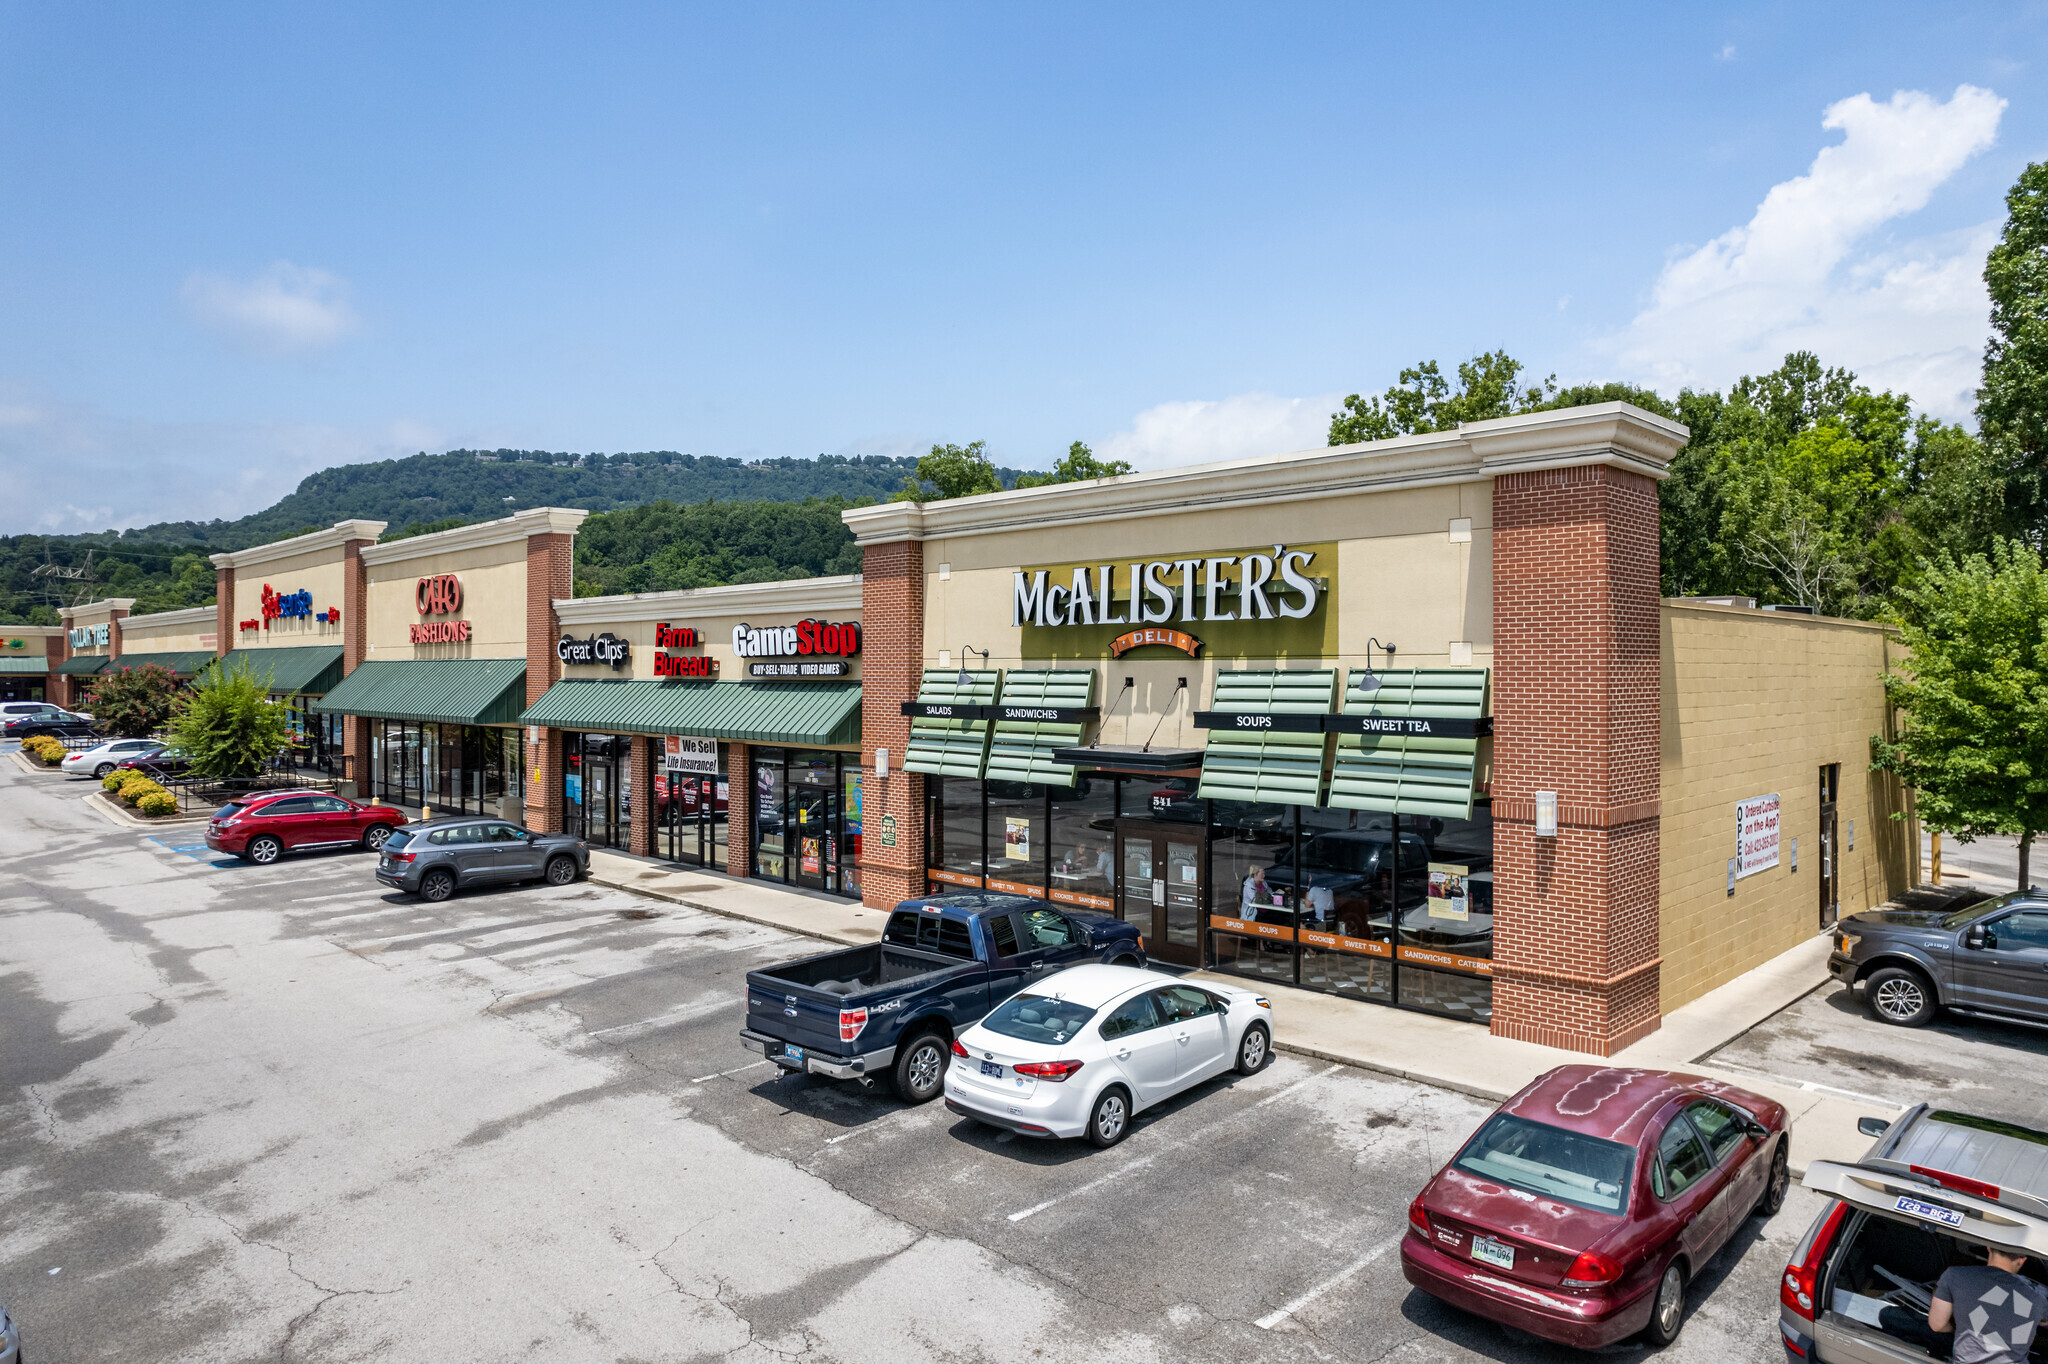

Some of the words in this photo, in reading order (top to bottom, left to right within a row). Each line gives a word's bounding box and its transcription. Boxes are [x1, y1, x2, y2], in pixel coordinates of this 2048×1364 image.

[1011, 544, 1319, 627] McALISTER'S
[415, 574, 460, 615] CATO
[94, 624, 109, 645] TREE
[409, 620, 468, 643] FASHIONS
[655, 622, 694, 647] Farm
[732, 620, 857, 657] GameStop
[1133, 631, 1173, 644] DELI
[557, 638, 591, 660] Great
[594, 637, 623, 666] Clips
[654, 651, 709, 676] Bureau
[800, 664, 818, 675] VIDEO
[818, 663, 840, 675] GAMES
[926, 706, 952, 716] SALADS
[1005, 708, 1058, 720] SANDWICHES
[1236, 715, 1272, 728] SOUPS
[1362, 719, 1404, 732] SWEET
[1408, 720, 1431, 733] TEA
[682, 739, 697, 753] We
[698, 740, 715, 754] Sell
[667, 755, 680, 769] Life
[680, 756, 717, 772] Insurance!
[1153, 796, 1171, 807] 541
[1745, 802, 1762, 818] Ordered
[1762, 798, 1779, 814] Curbside
[1745, 824, 1753, 835] on
[1754, 819, 1764, 832] the
[1765, 813, 1779, 831] App?
[936, 873, 955, 881] CATERING
[961, 876, 976, 884] SOUPS
[991, 882, 1005, 890] SWEET
[1006, 883, 1015, 891] TEA
[1027, 887, 1042, 895] SPUDS
[1054, 892, 1074, 901] COOKIES
[1078, 896, 1110, 907] SANDWICHES
[1226, 920, 1244, 930] SPUDS
[1258, 926, 1278, 935] SOUPS
[1308, 934, 1336, 945] COOKIES
[1344, 940, 1367, 950] SWEET
[1368, 942, 1382, 953] TEA
[1404, 950, 1452, 964] SANDWICHES
[1900, 1200, 1921, 1212] 728
[1930, 1208, 1959, 1223] BGFR
